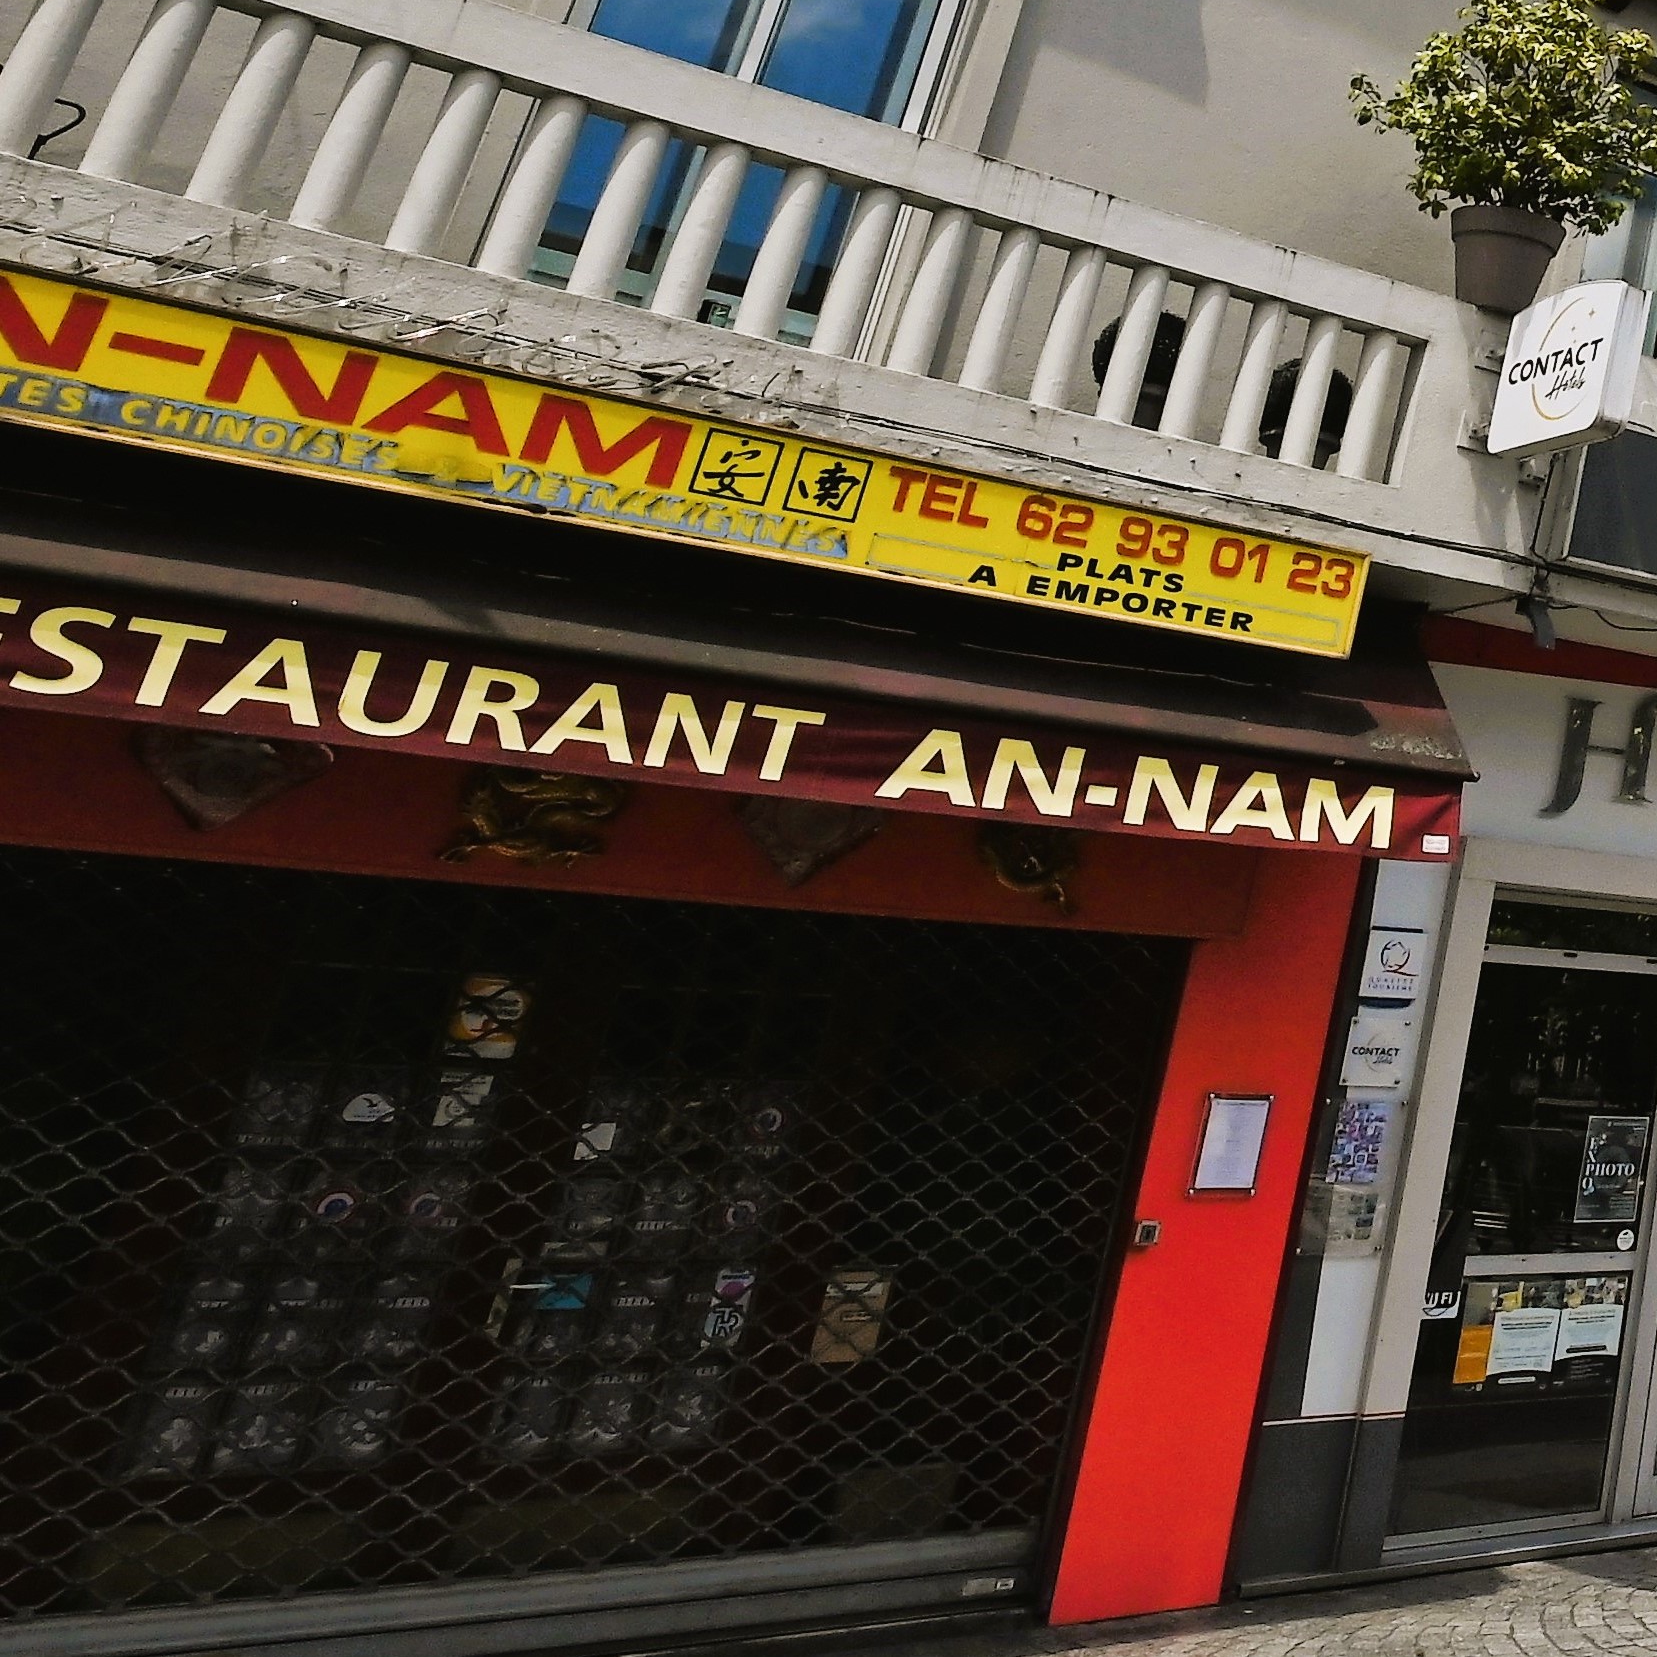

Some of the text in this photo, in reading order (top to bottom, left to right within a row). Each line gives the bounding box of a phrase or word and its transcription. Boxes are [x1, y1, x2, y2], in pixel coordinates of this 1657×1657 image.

[1508, 337, 1604, 385] CONTACT
[120, 399, 400, 472] CHINOISES
[493, 463, 846, 553] VIETNAMIENNES
[889, 465, 1355, 599] TEL 62 93 01 23
[967, 563, 1255, 633] A EMPORTER
[1056, 553, 1185, 594] PLATS
[0, 597, 1397, 850] STAURANT AN-NAM
[1351, 1046, 1400, 1058] CONTACT
[1585, 1162, 1636, 1177] PHOTO
